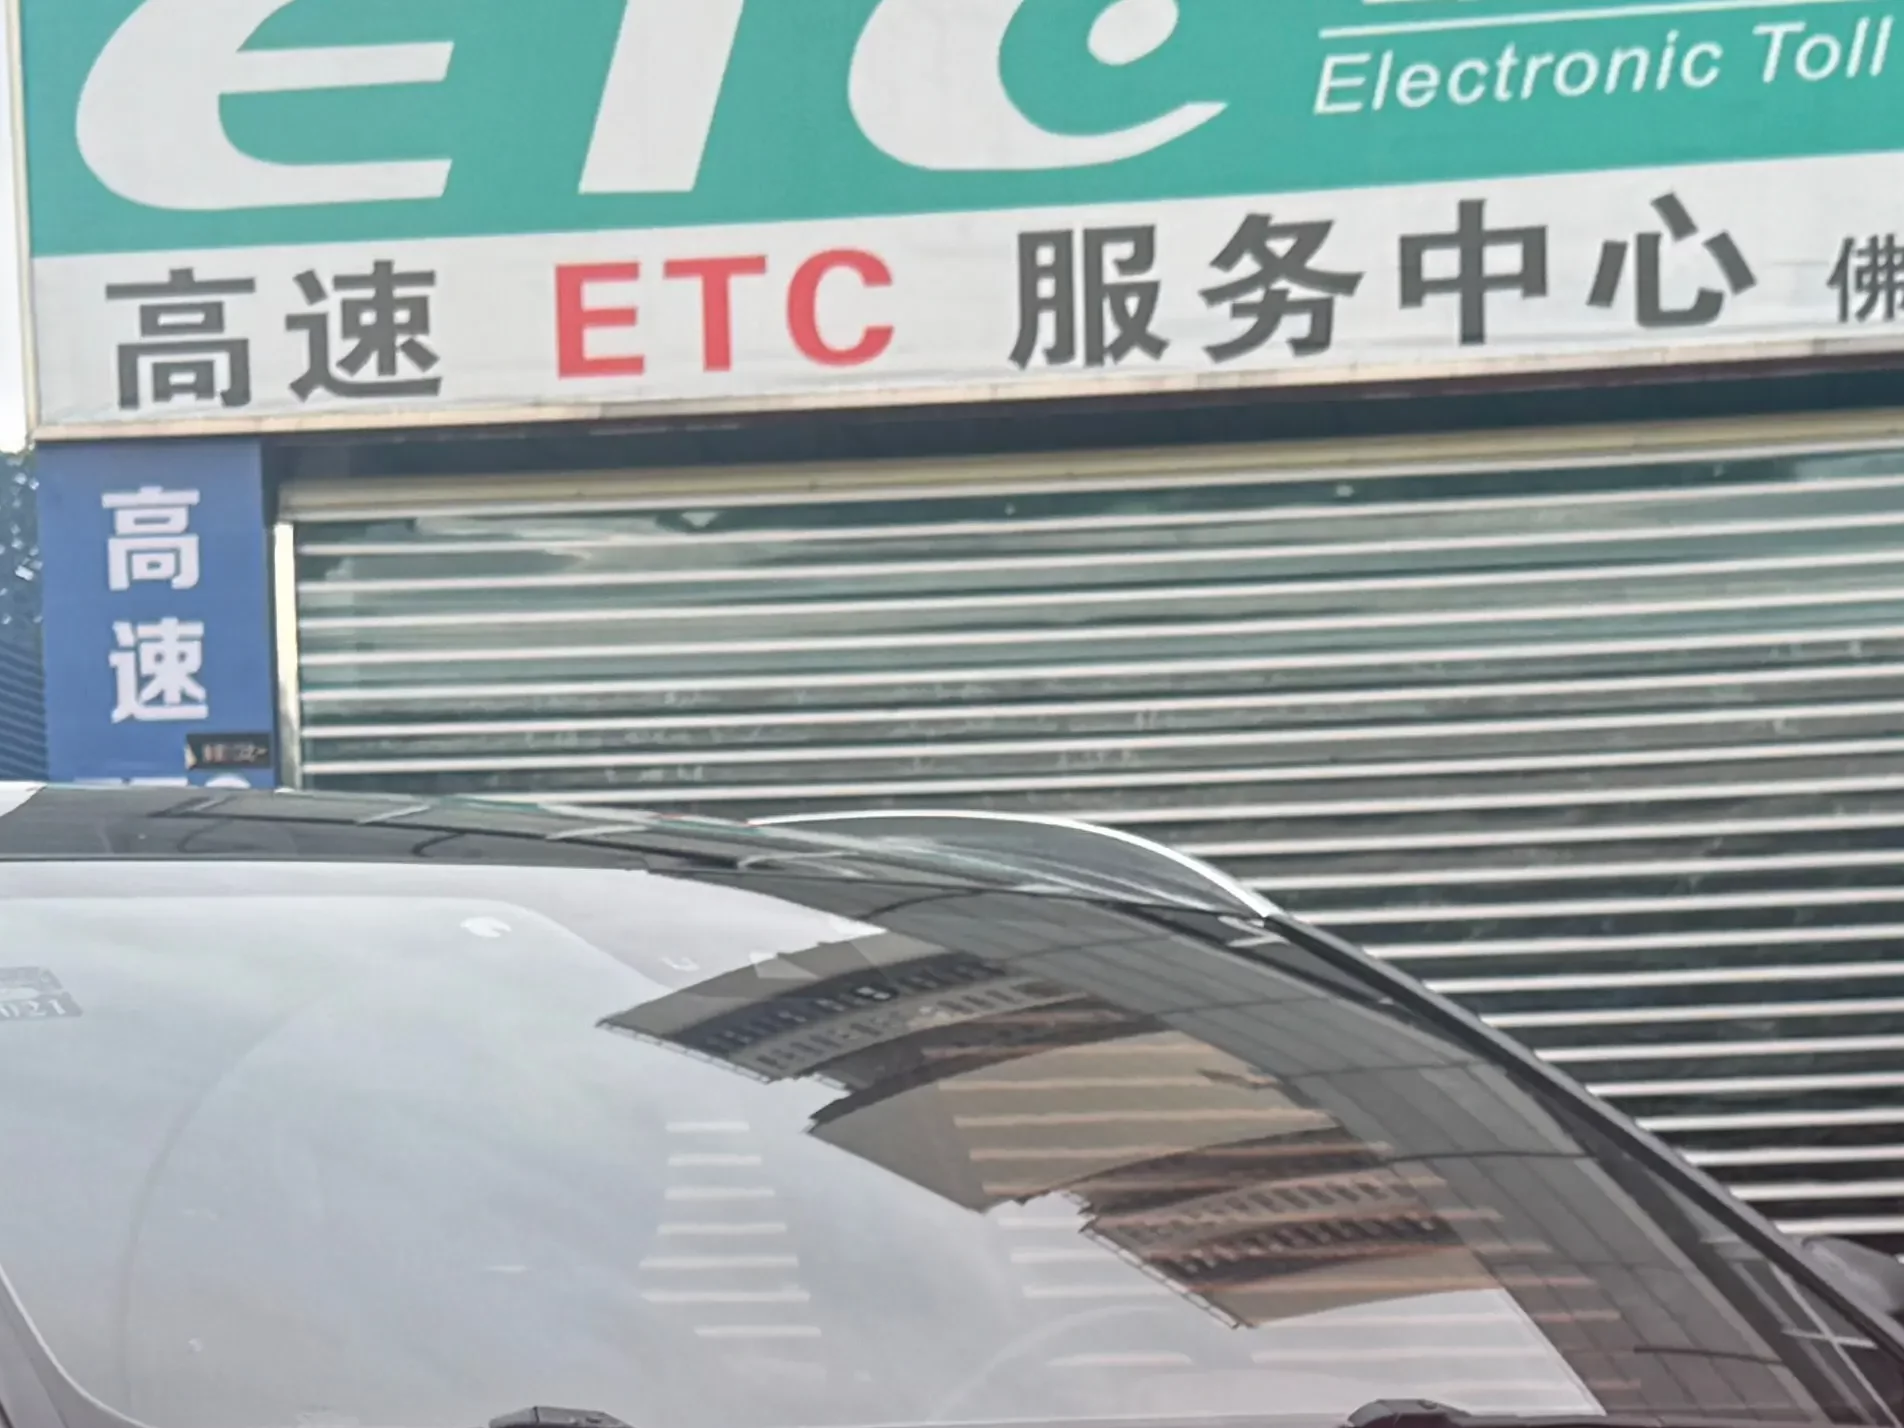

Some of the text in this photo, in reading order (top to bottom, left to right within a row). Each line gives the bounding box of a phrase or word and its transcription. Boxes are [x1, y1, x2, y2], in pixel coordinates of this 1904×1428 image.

[1313, 28, 1723, 115] Electronic
[1752, 15, 1894, 84] Toll
[104, 257, 444, 412] 高速
[554, 247, 896, 379] ETC
[1008, 191, 1758, 370] 服务中心
[100, 484, 210, 725] 高速
